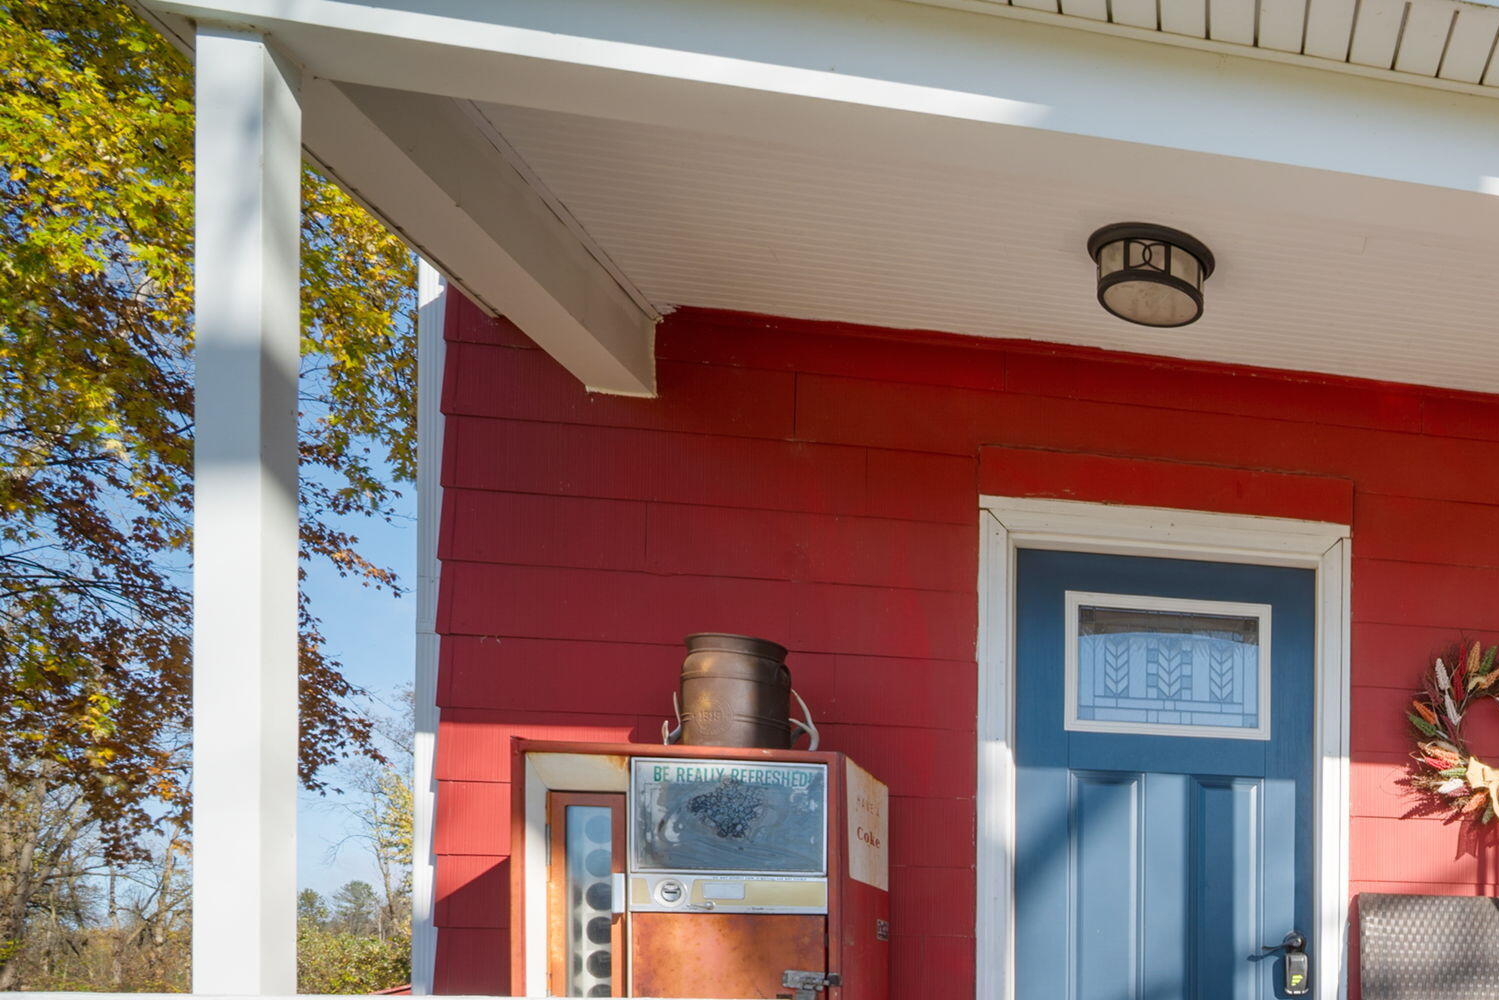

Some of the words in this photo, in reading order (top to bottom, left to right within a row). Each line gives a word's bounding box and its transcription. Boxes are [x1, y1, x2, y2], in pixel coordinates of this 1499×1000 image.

[653, 766, 670, 782] BE
[676, 767, 725, 783] REALLY
[856, 826, 881, 848] Coke
